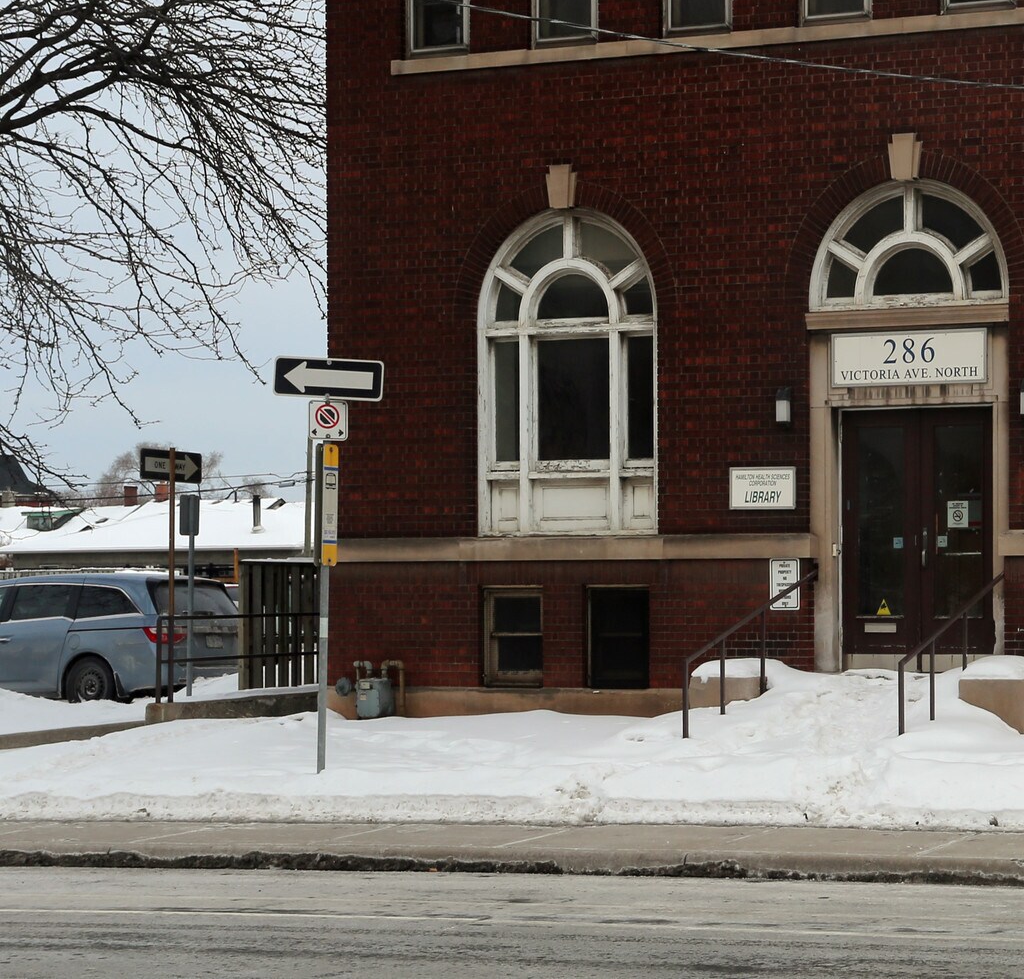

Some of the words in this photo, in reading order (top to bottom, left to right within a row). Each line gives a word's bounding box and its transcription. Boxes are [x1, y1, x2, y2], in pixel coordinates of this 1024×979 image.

[883, 337, 935, 364] 286
[841, 369, 900, 381] VICTORIA
[904, 368, 932, 380] AVE.
[935, 366, 978, 378] NORTH
[154, 461, 166, 470] ONE
[744, 490, 782, 504] LIBRARY
